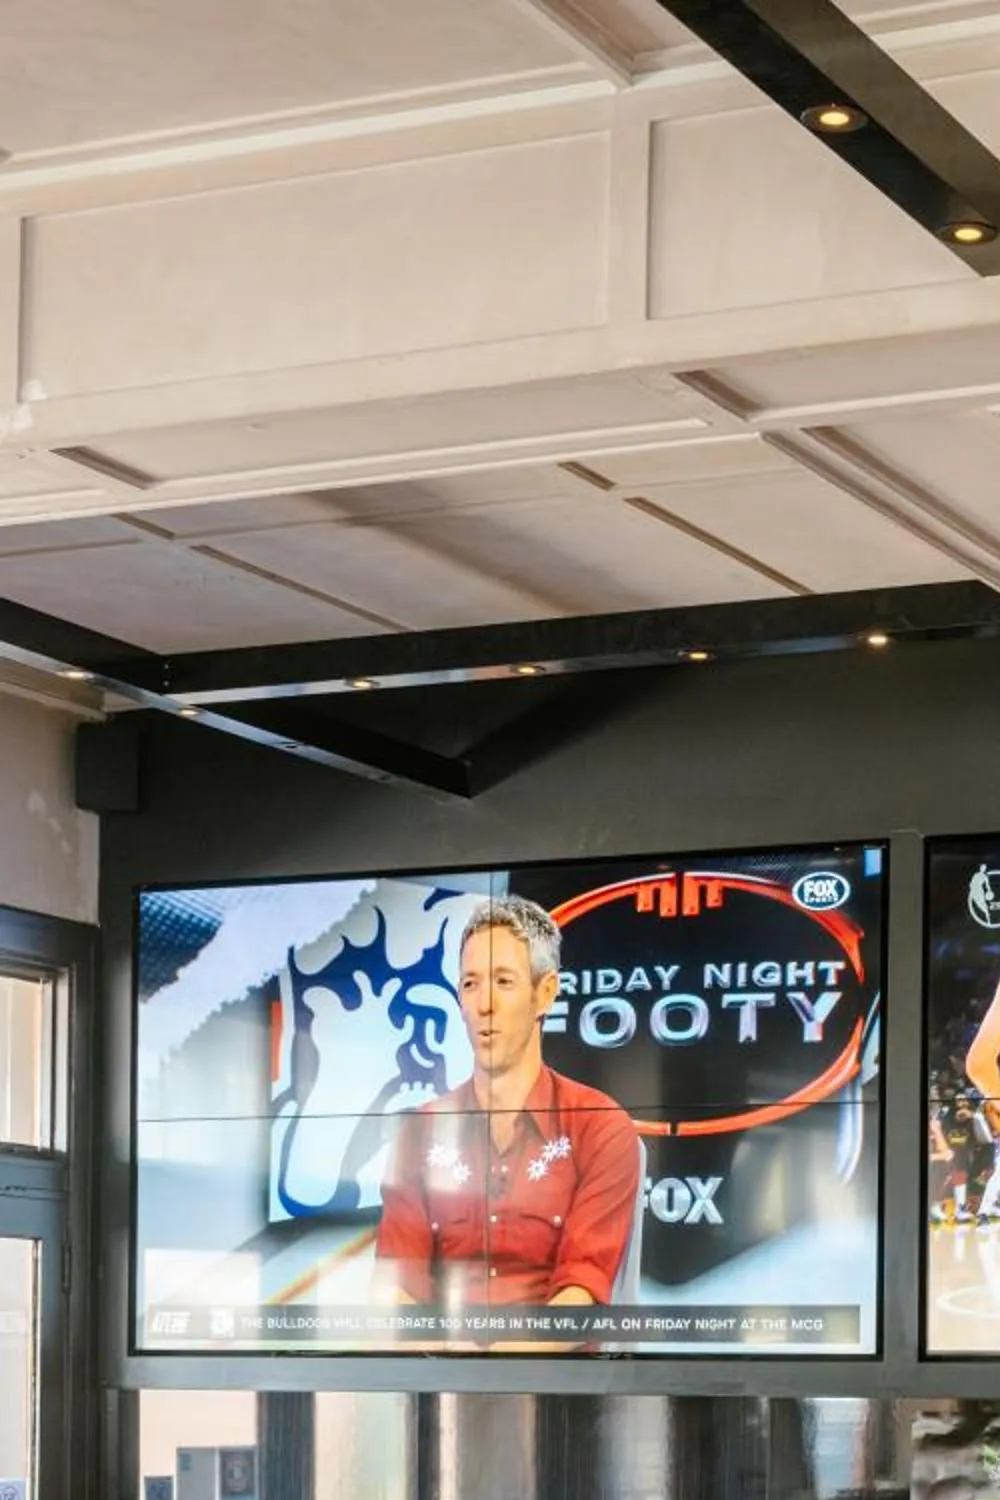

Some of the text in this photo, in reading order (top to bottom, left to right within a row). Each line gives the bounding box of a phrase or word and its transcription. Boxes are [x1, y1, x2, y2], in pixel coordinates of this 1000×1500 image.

[803, 879, 838, 897] FOX
[559, 960, 845, 995] RIDAY NIGHT
[366, 1317, 435, 1330] CELEBRATE
[439, 1317, 462, 1330] 100
[465, 1317, 505, 1330] YEARS
[509, 1317, 522, 1330] IN
[526, 1317, 550, 1330] THE
[553, 1317, 579, 1330] VFL
[592, 1317, 617, 1330] AFL
[621, 1317, 641, 1330] ON
[644, 1317, 690, 1330] FRIDAY
[695, 1317, 736, 1330] NIGHT
[740, 1317, 756, 1330] AT
[760, 1317, 787, 1330] THE
[790, 1317, 823, 1330] MCG
